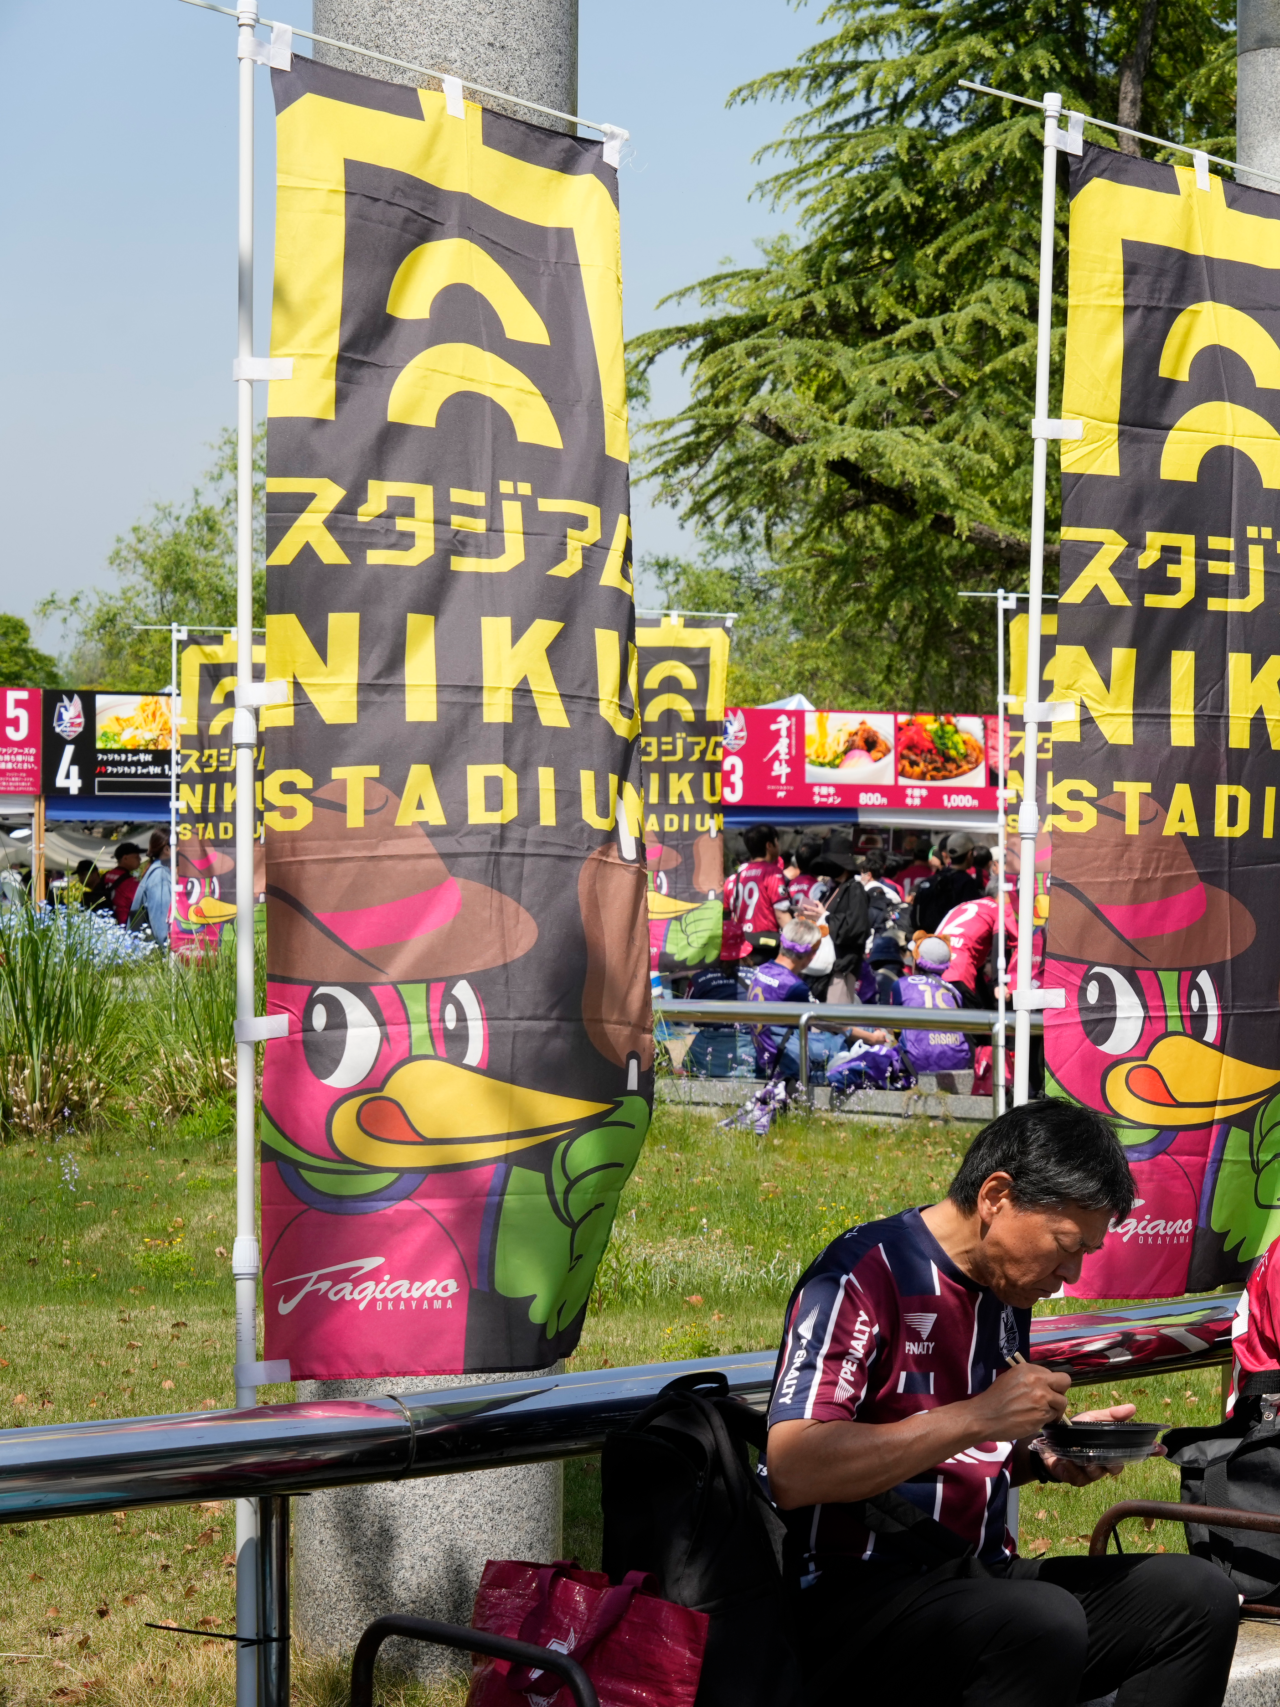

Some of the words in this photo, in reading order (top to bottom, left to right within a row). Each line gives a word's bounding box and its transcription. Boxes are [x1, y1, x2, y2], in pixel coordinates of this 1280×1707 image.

[259, 612, 641, 742] NIKU
[5, 690, 29, 741] 5
[641, 733, 723, 762] タジアム
[55, 744, 82, 795] 4
[723, 755, 744, 803] 3
[649, 772, 722, 805] IKU
[858, 793, 888, 806] 800円
[942, 795, 979, 808] 1,000円
[645, 813, 723, 833] ADIUM
[929, 1033, 960, 1045] SASAKI
[1138, 1236, 1189, 1245] OKAYAMA
[272, 1256, 460, 1315] Fagiano
[376, 1300, 454, 1311] OKAYAMA
[842, 1310, 870, 1381] PENALTY
